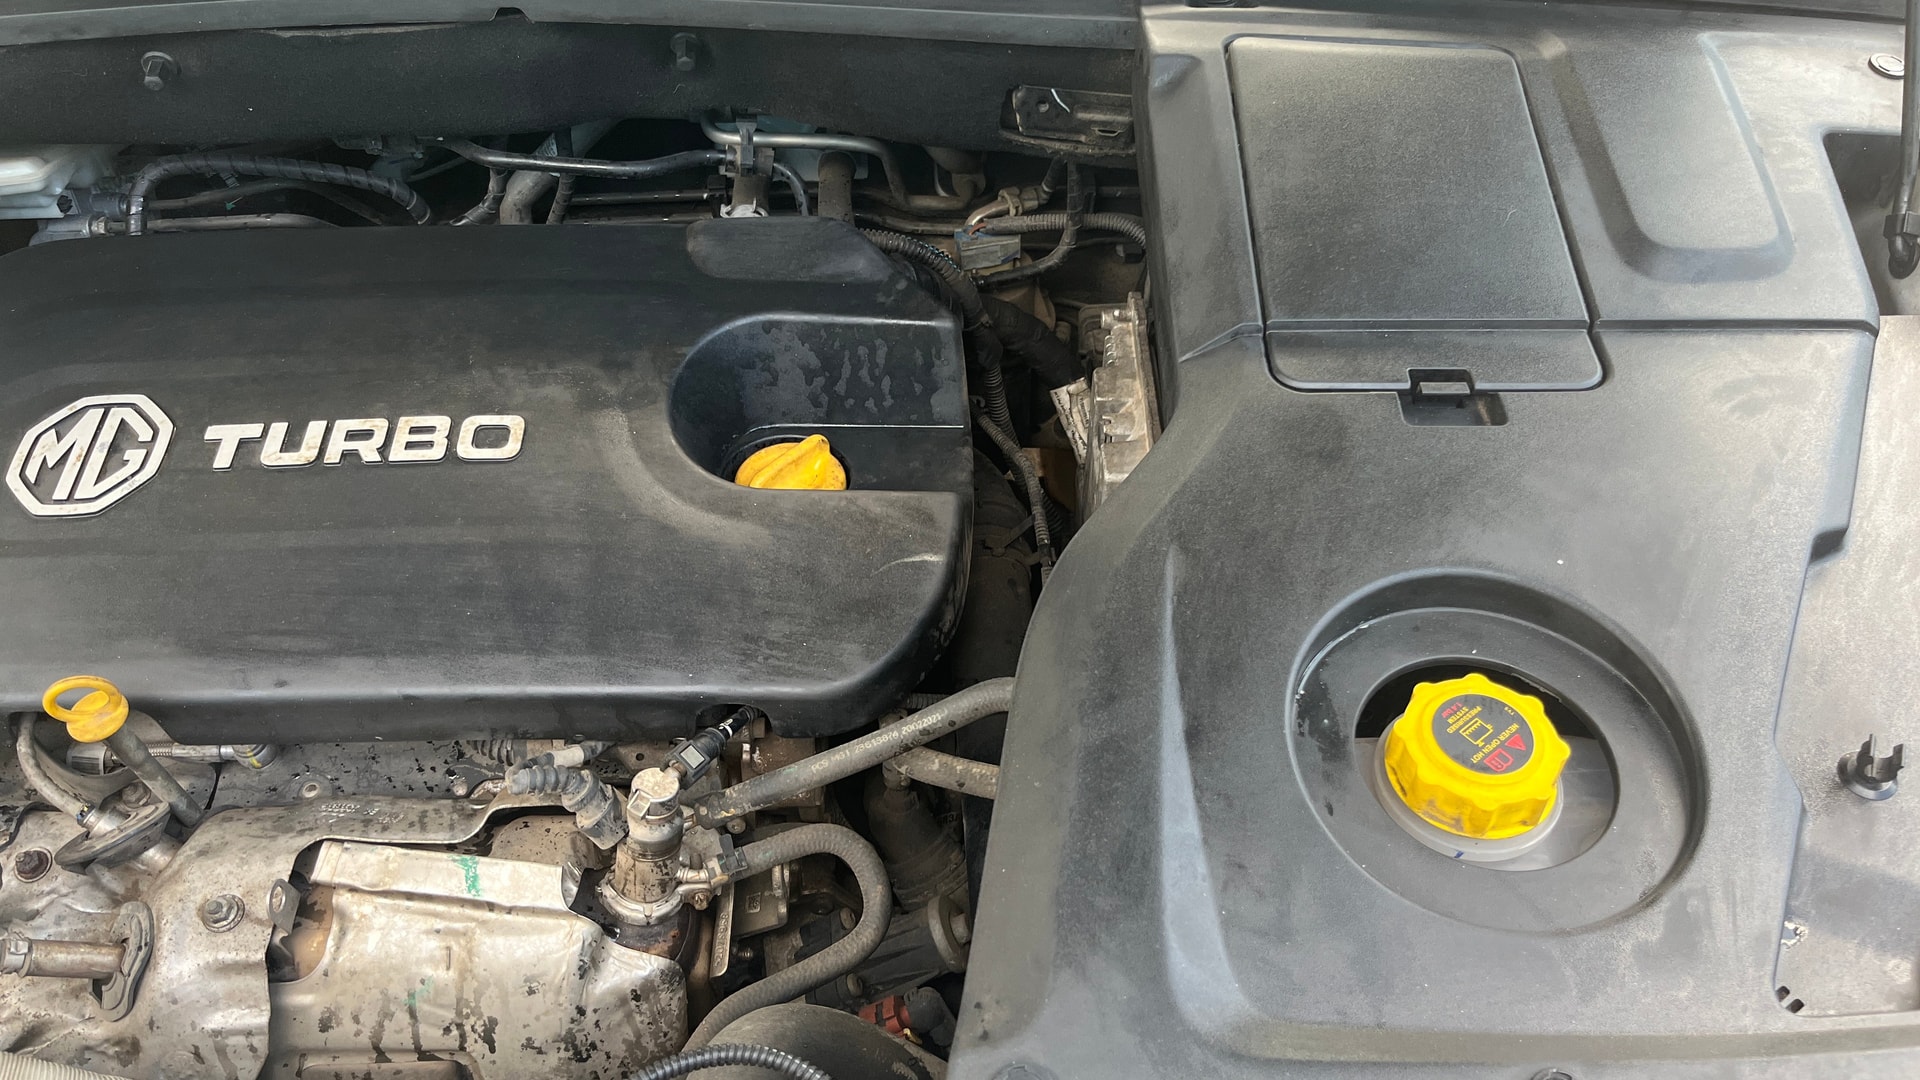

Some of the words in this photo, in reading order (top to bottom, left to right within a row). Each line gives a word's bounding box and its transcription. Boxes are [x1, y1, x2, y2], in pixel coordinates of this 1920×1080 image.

[204, 414, 527, 470] TURBO
[26, 407, 154, 500] MG
[1447, 706, 1469, 723] SYSTEM
[1499, 723, 1519, 741] NEVER
[1483, 738, 1500, 753] OPEN
[1471, 751, 1486, 763] HOT
